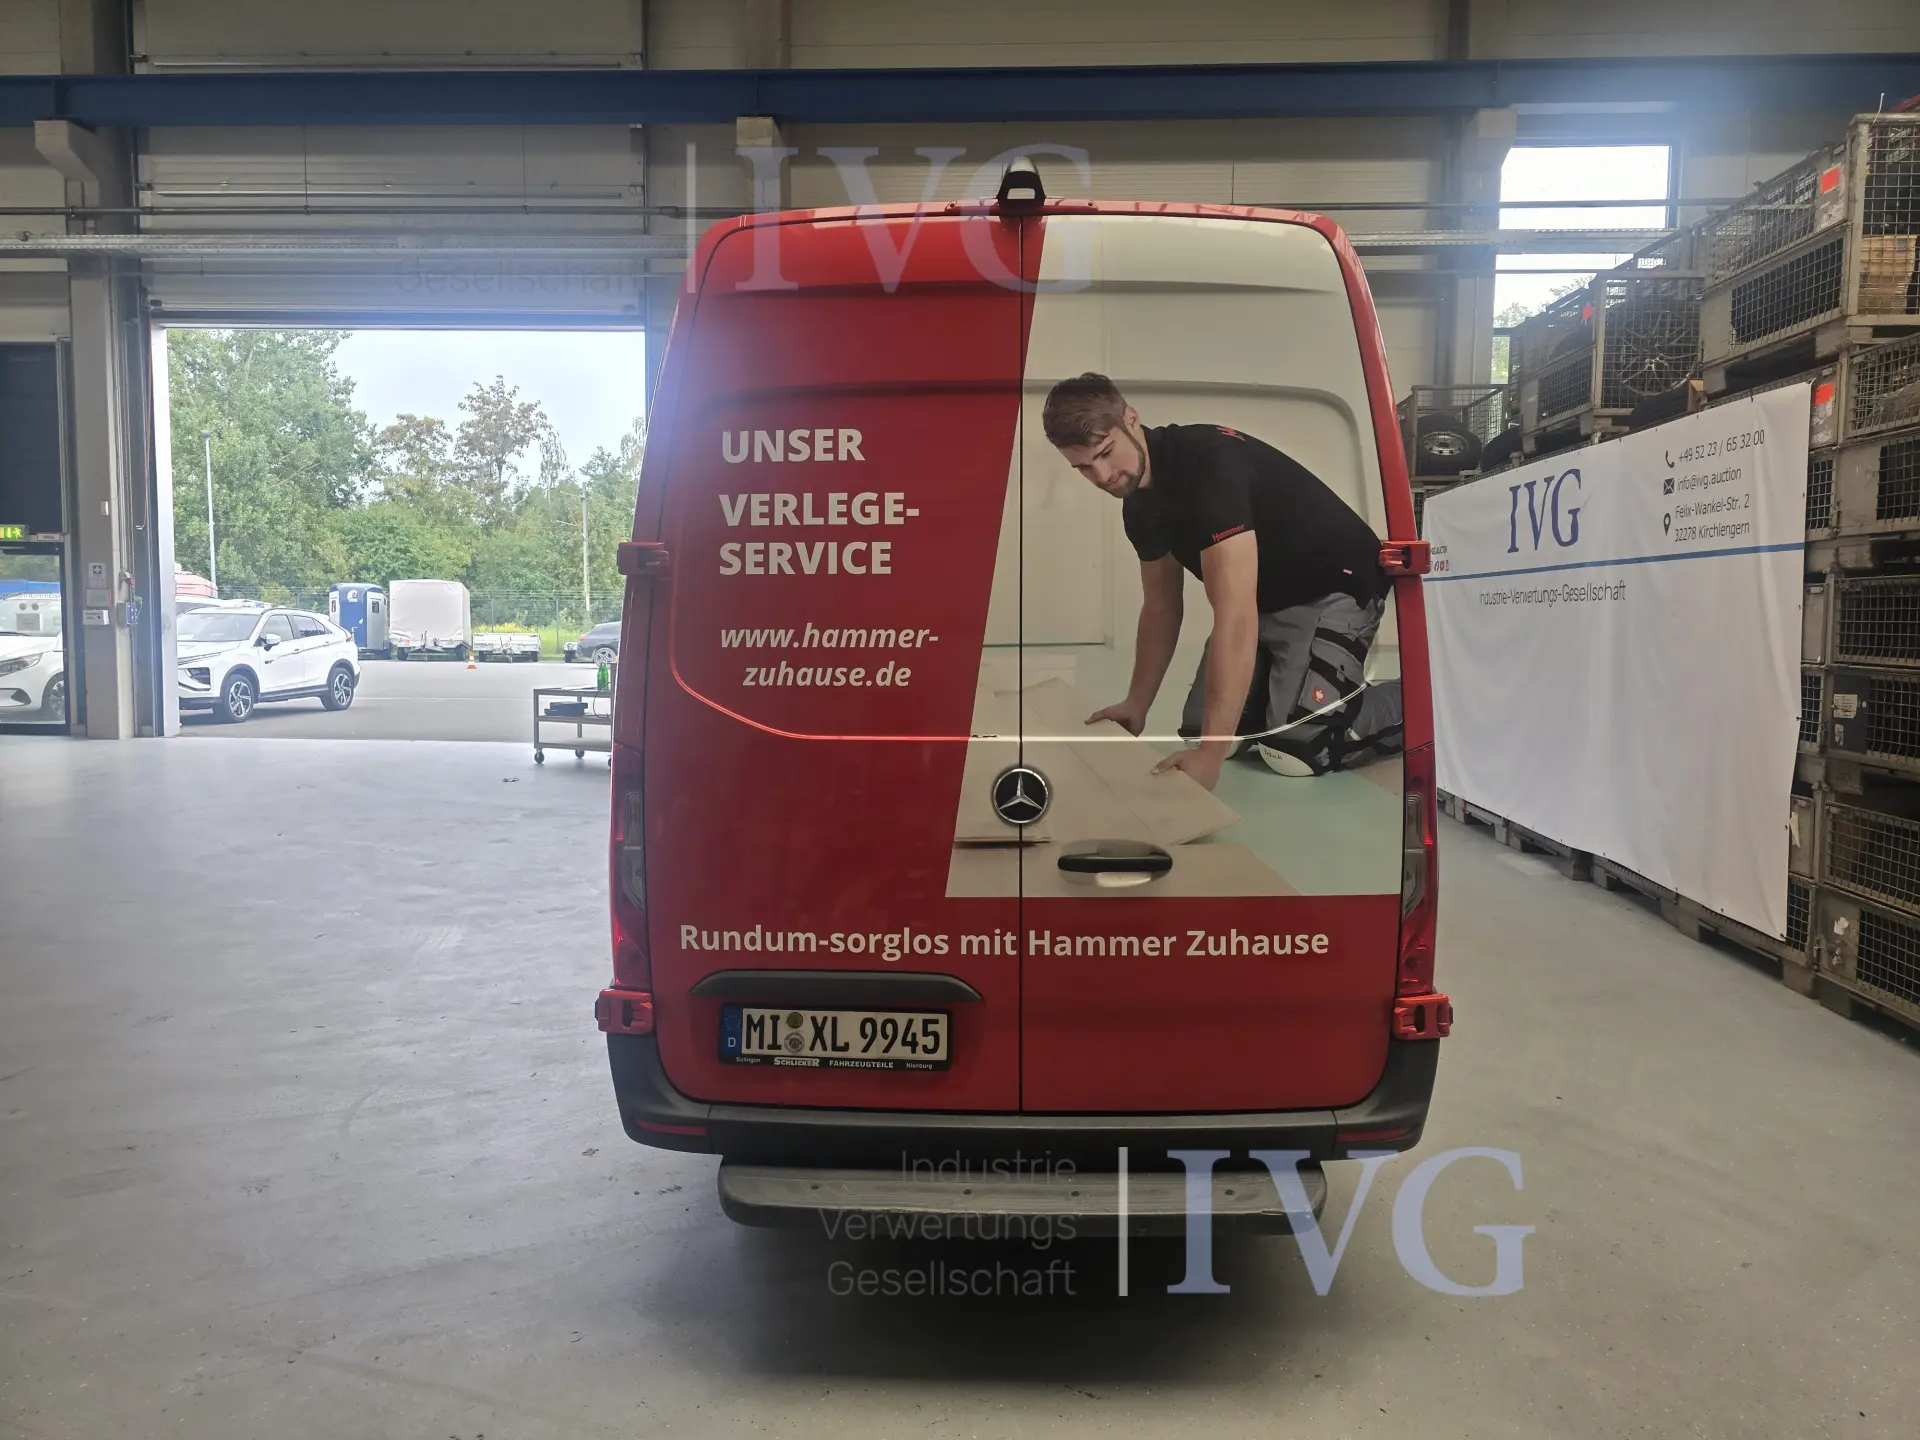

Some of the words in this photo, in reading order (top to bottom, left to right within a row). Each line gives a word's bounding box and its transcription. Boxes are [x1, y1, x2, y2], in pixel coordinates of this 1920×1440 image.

[722, 428, 865, 463] UNSER
[1679, 448, 1693, 463] +49
[1695, 445, 1705, 460] 52
[1707, 441, 1718, 457] 23
[1726, 436, 1738, 452] 65
[1740, 432, 1751, 449] 32
[1753, 429, 1765, 446] 00
[1677, 467, 1742, 492] info@ivg.auction
[719, 492, 920, 526] VERLEGE-
[1508, 468, 1582, 553] IVG
[1675, 496, 1741, 519] Felix-Wankel-Str.
[1744, 493, 1750, 509] 2
[1211, 524, 1245, 542] Hammer
[1675, 526, 1697, 542] 32278
[1699, 522, 1750, 539] Kirchlengern
[719, 541, 892, 575] SERVICE
[1479, 579, 1626, 608] Industrie-Verwertungs-Gesellschaft
[720, 622, 939, 649] www.hammer-
[742, 661, 912, 688] zuhause.de
[679, 924, 949, 961] Rundum-sorglos
[961, 928, 1017, 956] mit
[1028, 929, 1177, 957] Hammer
[1186, 928, 1330, 957] Zuhause
[727, 1036, 736, 1048] D
[745, 1014, 783, 1051] MI
[809, 1015, 850, 1052] XL
[859, 1016, 941, 1055] 9945
[829, 1059, 894, 1069] FAHRZEUGTEILE
